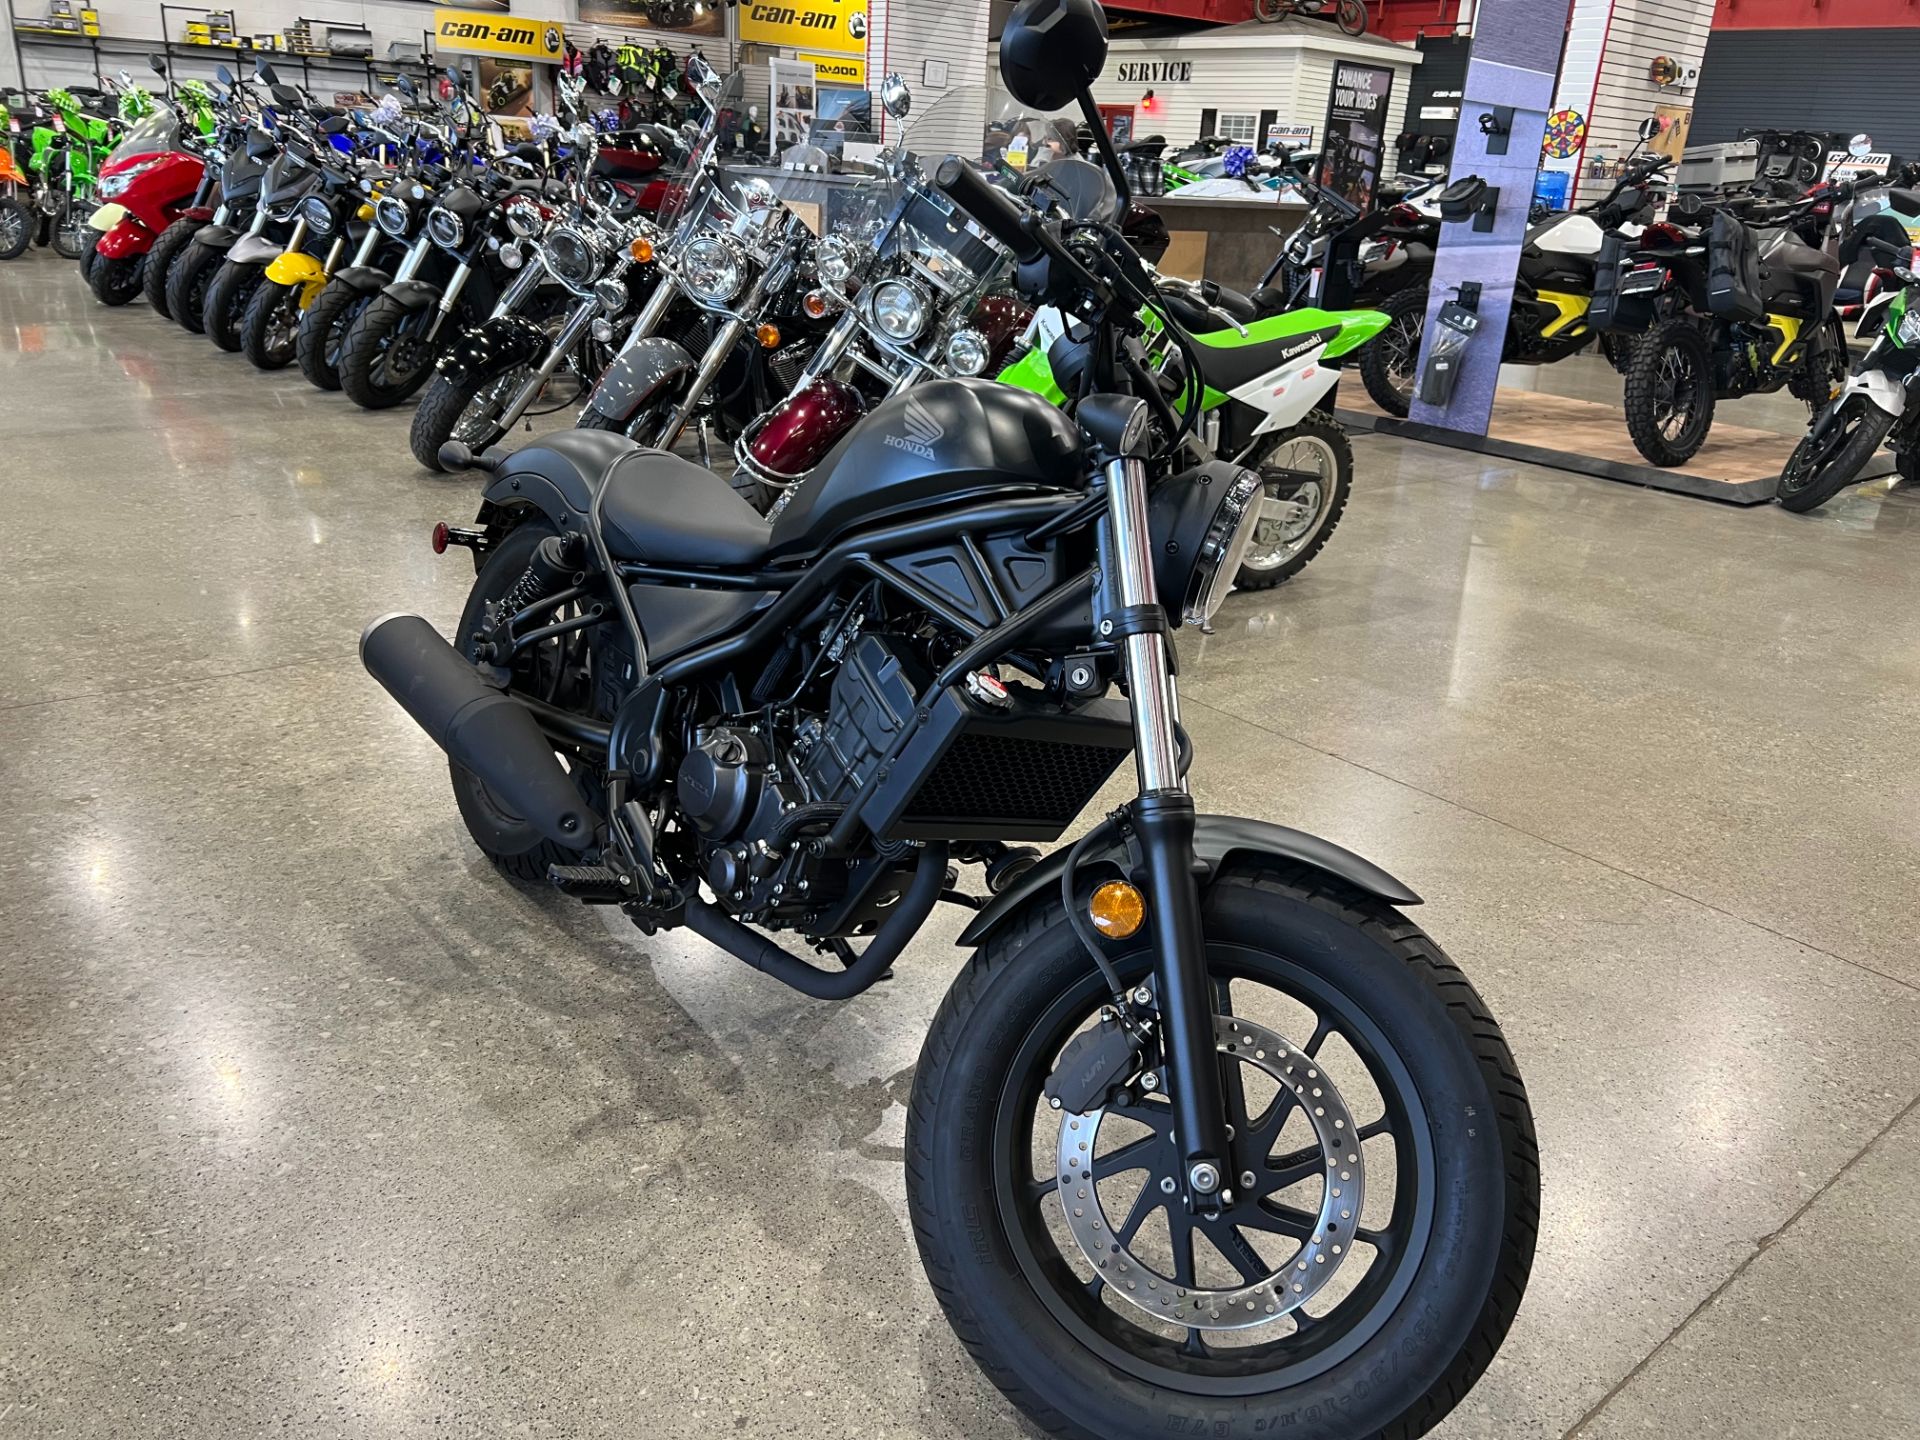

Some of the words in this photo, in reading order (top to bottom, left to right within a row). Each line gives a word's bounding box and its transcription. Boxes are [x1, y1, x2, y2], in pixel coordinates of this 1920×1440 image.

[751, 5, 837, 30] can-am
[441, 22, 535, 45] can-am
[1118, 62, 1191, 82] SERVICE
[1337, 69, 1373, 90] ENHANCE
[1335, 89, 1356, 108] YOUR
[1355, 92, 1378, 110] RIDES
[1269, 126, 1310, 135] can-am
[1281, 333, 1322, 360] Kawasaki
[883, 434, 936, 462] HONDA
